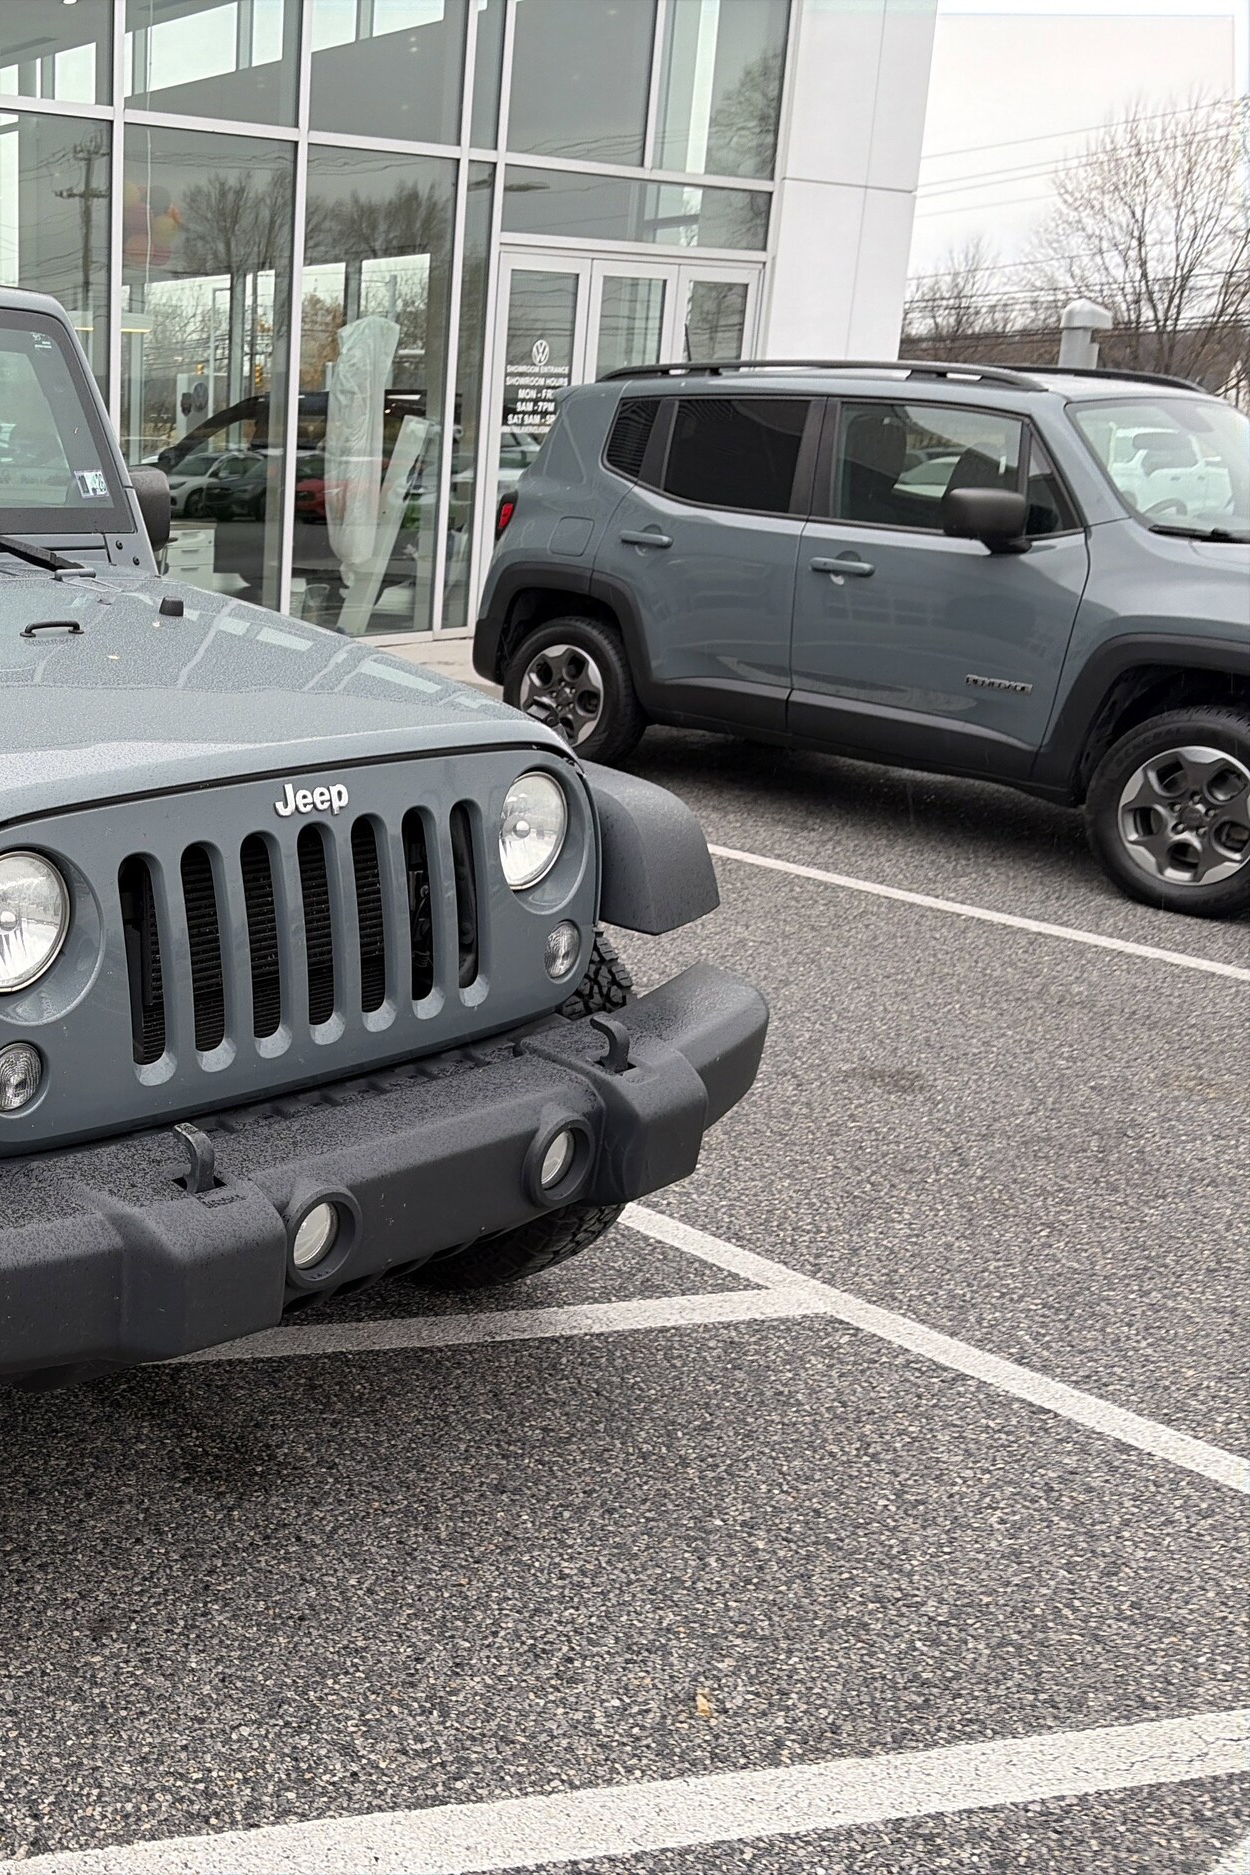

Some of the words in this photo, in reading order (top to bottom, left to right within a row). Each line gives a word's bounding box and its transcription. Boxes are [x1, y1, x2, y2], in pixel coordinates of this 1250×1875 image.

[507, 365, 539, 373] SHOWROOM
[540, 366, 569, 374] ENTRANCE
[506, 376, 545, 386] SHOWROOM
[545, 377, 568, 387] HOURS
[518, 388, 537, 399] MON
[541, 388, 556, 399] FR
[507, 413, 523, 424] SAT
[274, 783, 349, 817] Jeep
